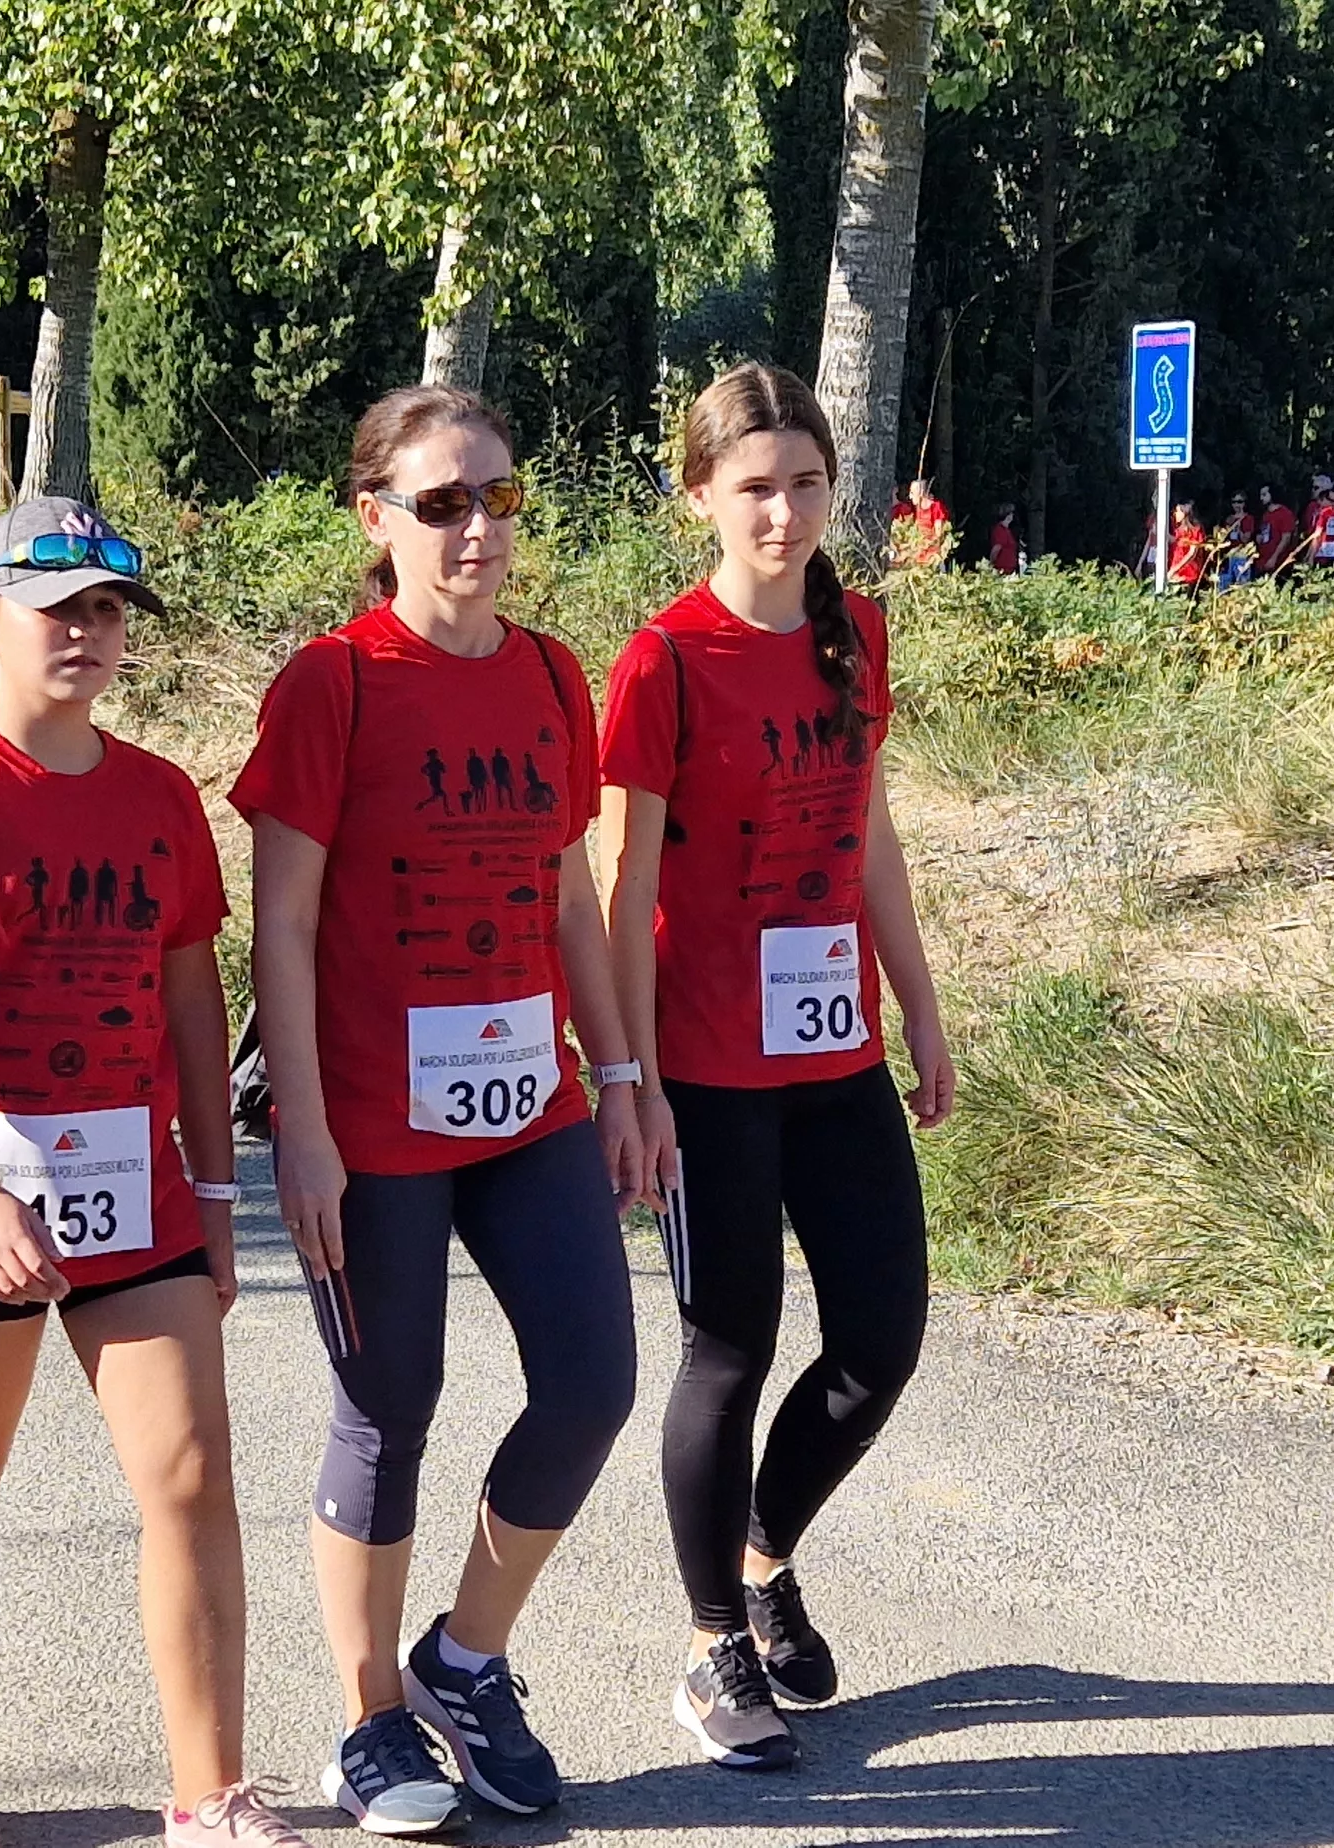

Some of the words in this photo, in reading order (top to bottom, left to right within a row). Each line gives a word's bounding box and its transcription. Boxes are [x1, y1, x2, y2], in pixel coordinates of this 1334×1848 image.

[795, 994, 861, 1042] 30
[445, 1074, 537, 1127] 308
[30, 1190, 117, 1246] 153
